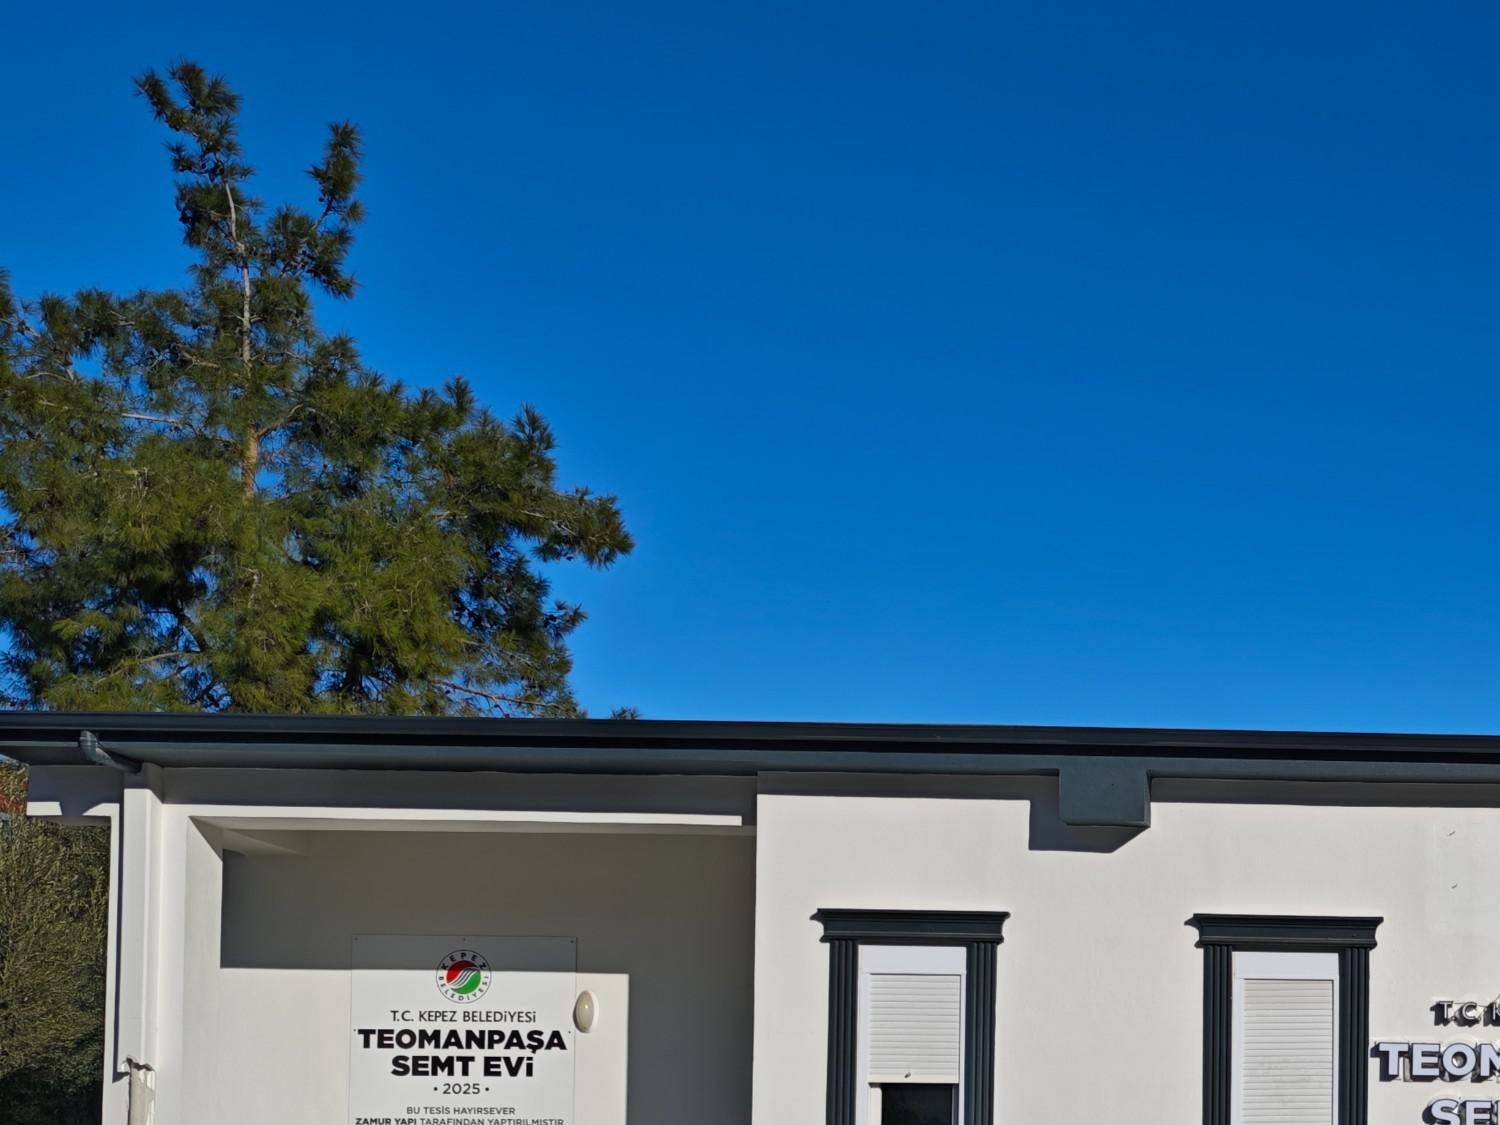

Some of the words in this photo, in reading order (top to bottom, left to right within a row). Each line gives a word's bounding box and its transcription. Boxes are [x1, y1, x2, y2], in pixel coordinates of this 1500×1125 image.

[441, 952, 487, 970] KEPEZ
[390, 1010, 414, 1021] T.C.
[418, 1010, 458, 1022] KEPEZ
[1439, 1001, 1481, 1021] T.C.
[357, 1028, 567, 1054] TEOMANPAŞA
[390, 1055, 475, 1076] SEMT
[442, 1083, 481, 1095] 2025
[406, 1106, 421, 1116] BU
[423, 1105, 451, 1116] TESİS
[453, 1106, 516, 1116] HAYIRSEVER
[355, 1117, 392, 1125] ZAMUR
[394, 1117, 417, 1125] YAPI
[420, 1117, 485, 1125] TARAFINDAN
